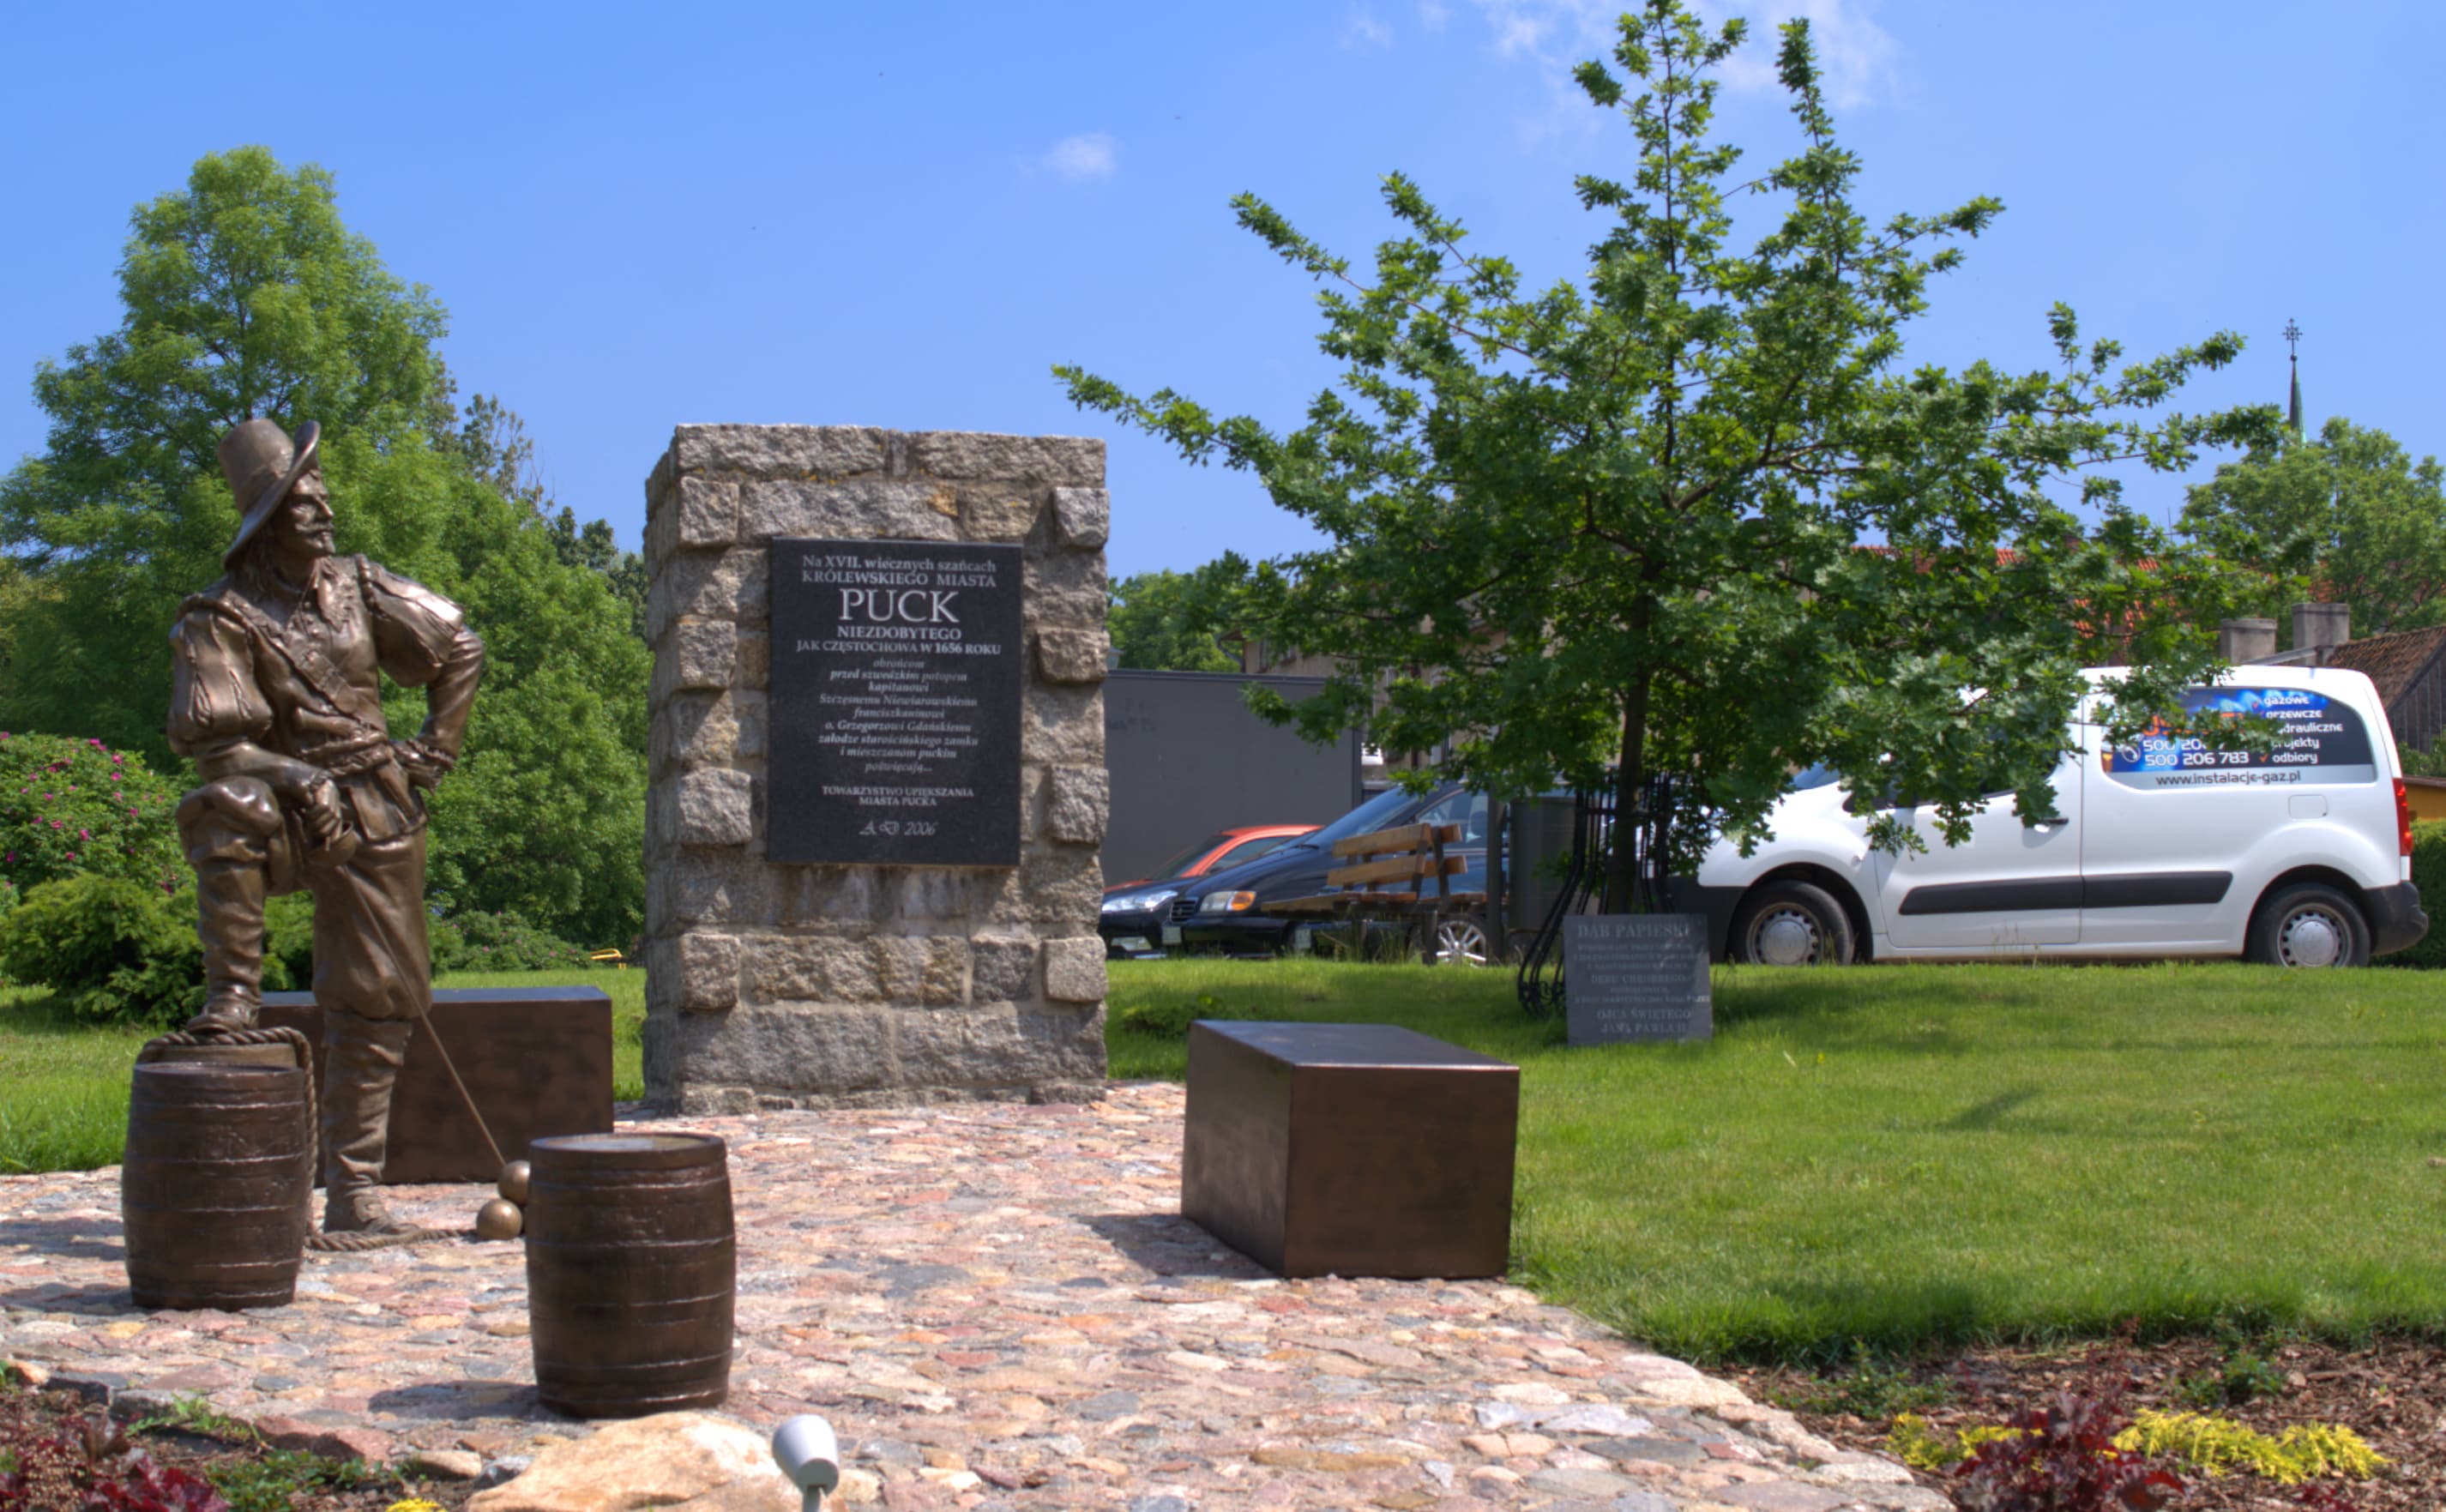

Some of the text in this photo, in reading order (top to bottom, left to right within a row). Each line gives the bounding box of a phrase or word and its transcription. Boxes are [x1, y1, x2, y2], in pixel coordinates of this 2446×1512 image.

[803, 556, 997, 576] Na XVII. wiecznych szańcach
[802, 569, 997, 587] KRÓLEWSKIEGO MIASTA
[839, 588, 960, 623] PUCK
[837, 626, 961, 640] NIEZDOBYTEGO
[797, 640, 1001, 654] JAK CZĘSTOCHOWA W 1656 ROKU
[830, 669, 860, 680] przed
[868, 682, 929, 693] kapitanowi
[2264, 696, 2310, 707] gazowe
[2277, 722, 2343, 733] drauliczne
[2145, 752, 2250, 767] 500 206 783
[2273, 751, 2318, 764] odbiory
[2155, 771, 2301, 786] www.instalacje-gaz.pl
[822, 786, 903, 796] TOWARZYSTWO
[859, 797, 937, 806] MIASTA PUCKA
[904, 822, 939, 835] 2006
